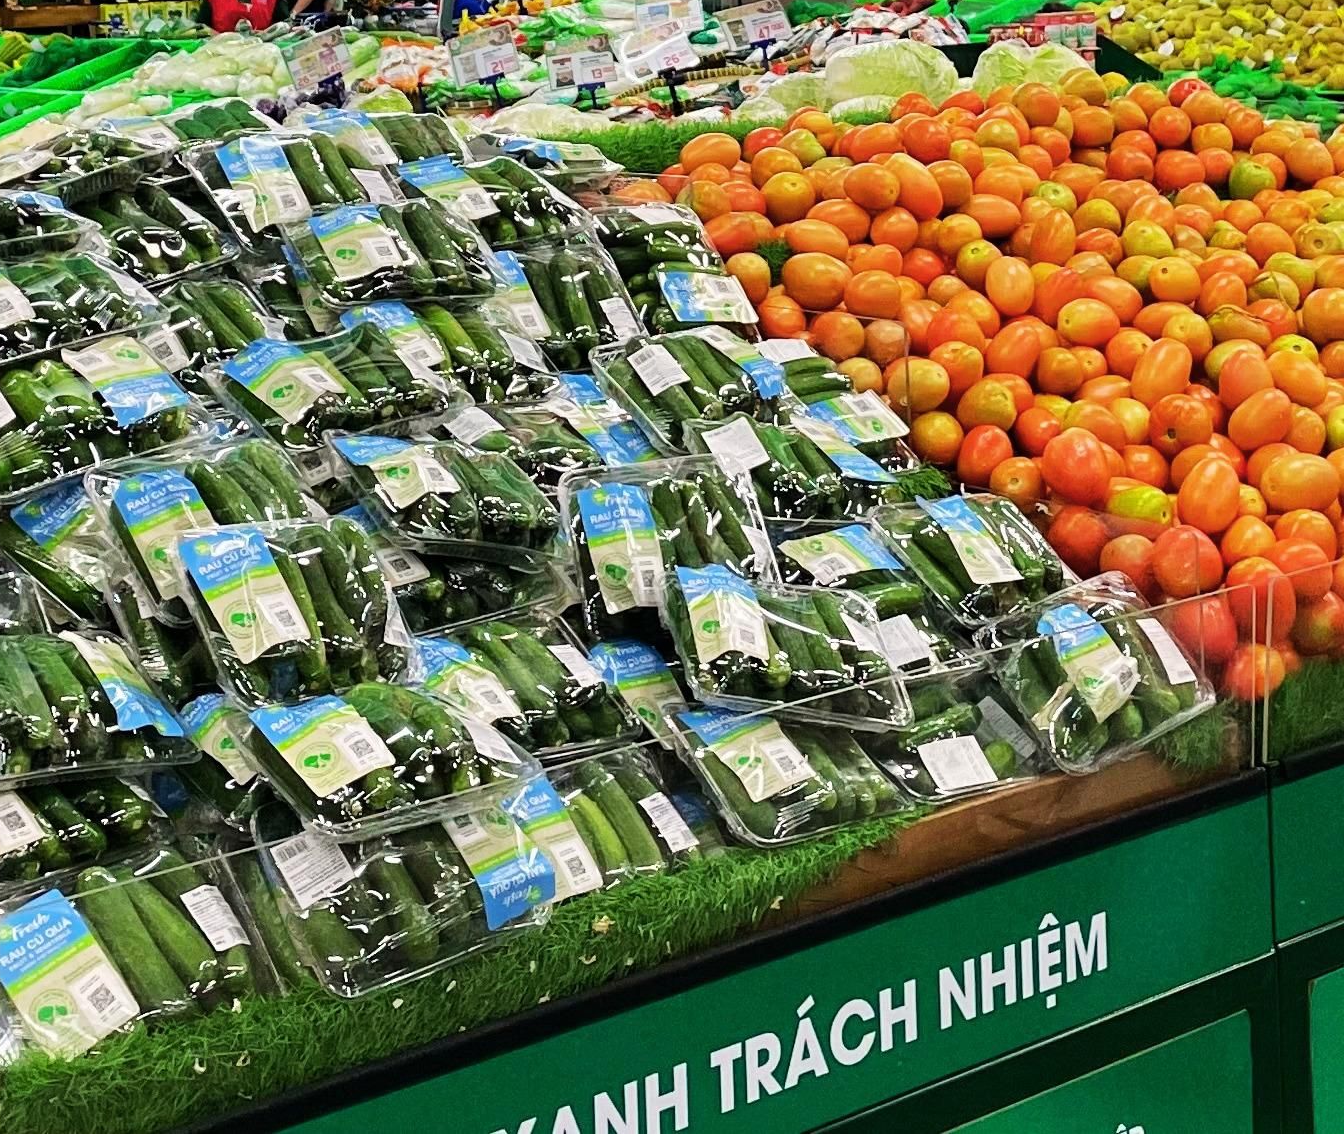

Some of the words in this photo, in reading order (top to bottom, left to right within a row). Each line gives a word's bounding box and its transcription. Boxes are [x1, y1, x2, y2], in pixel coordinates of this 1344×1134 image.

[11, 913, 50, 941] Fresh
[0, 947, 26, 968] RAU
[709, 978, 917, 1114] TRÁCH
[938, 912, 1108, 1030] NHIỆM
